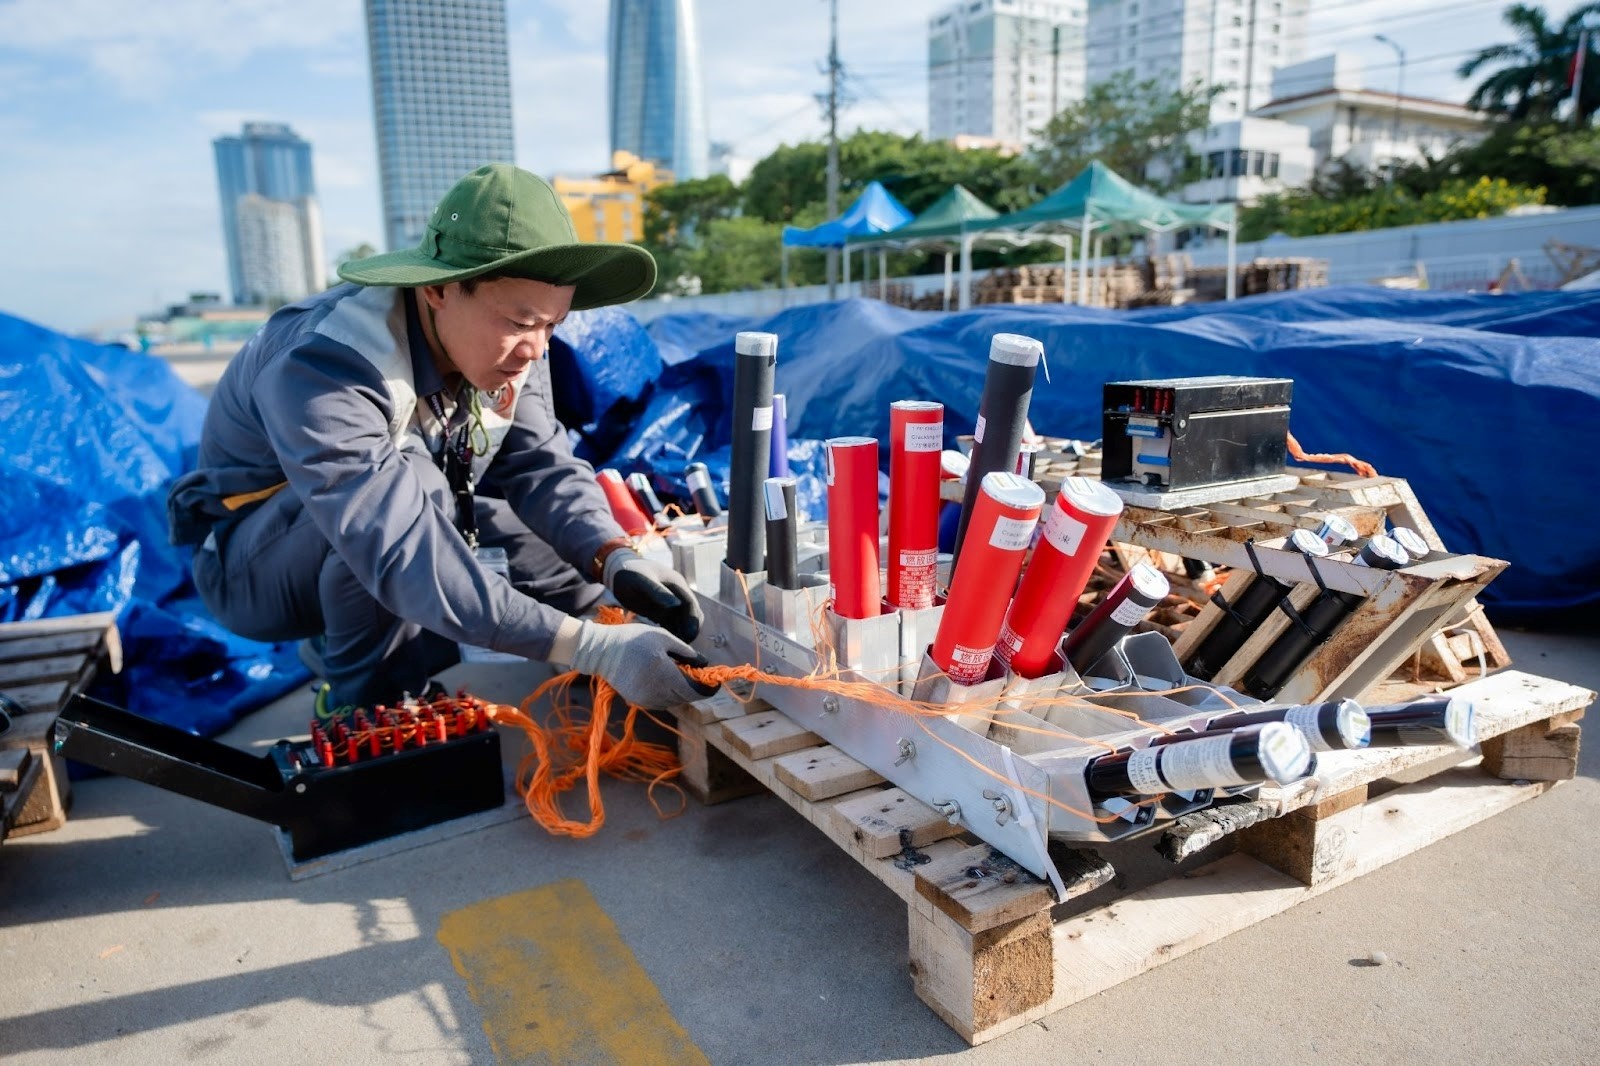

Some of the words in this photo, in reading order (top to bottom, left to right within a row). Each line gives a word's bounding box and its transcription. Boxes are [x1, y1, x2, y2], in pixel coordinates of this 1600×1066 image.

[905, 553, 937, 566] 燃放说
[959, 645, 993, 664] 燃放说
